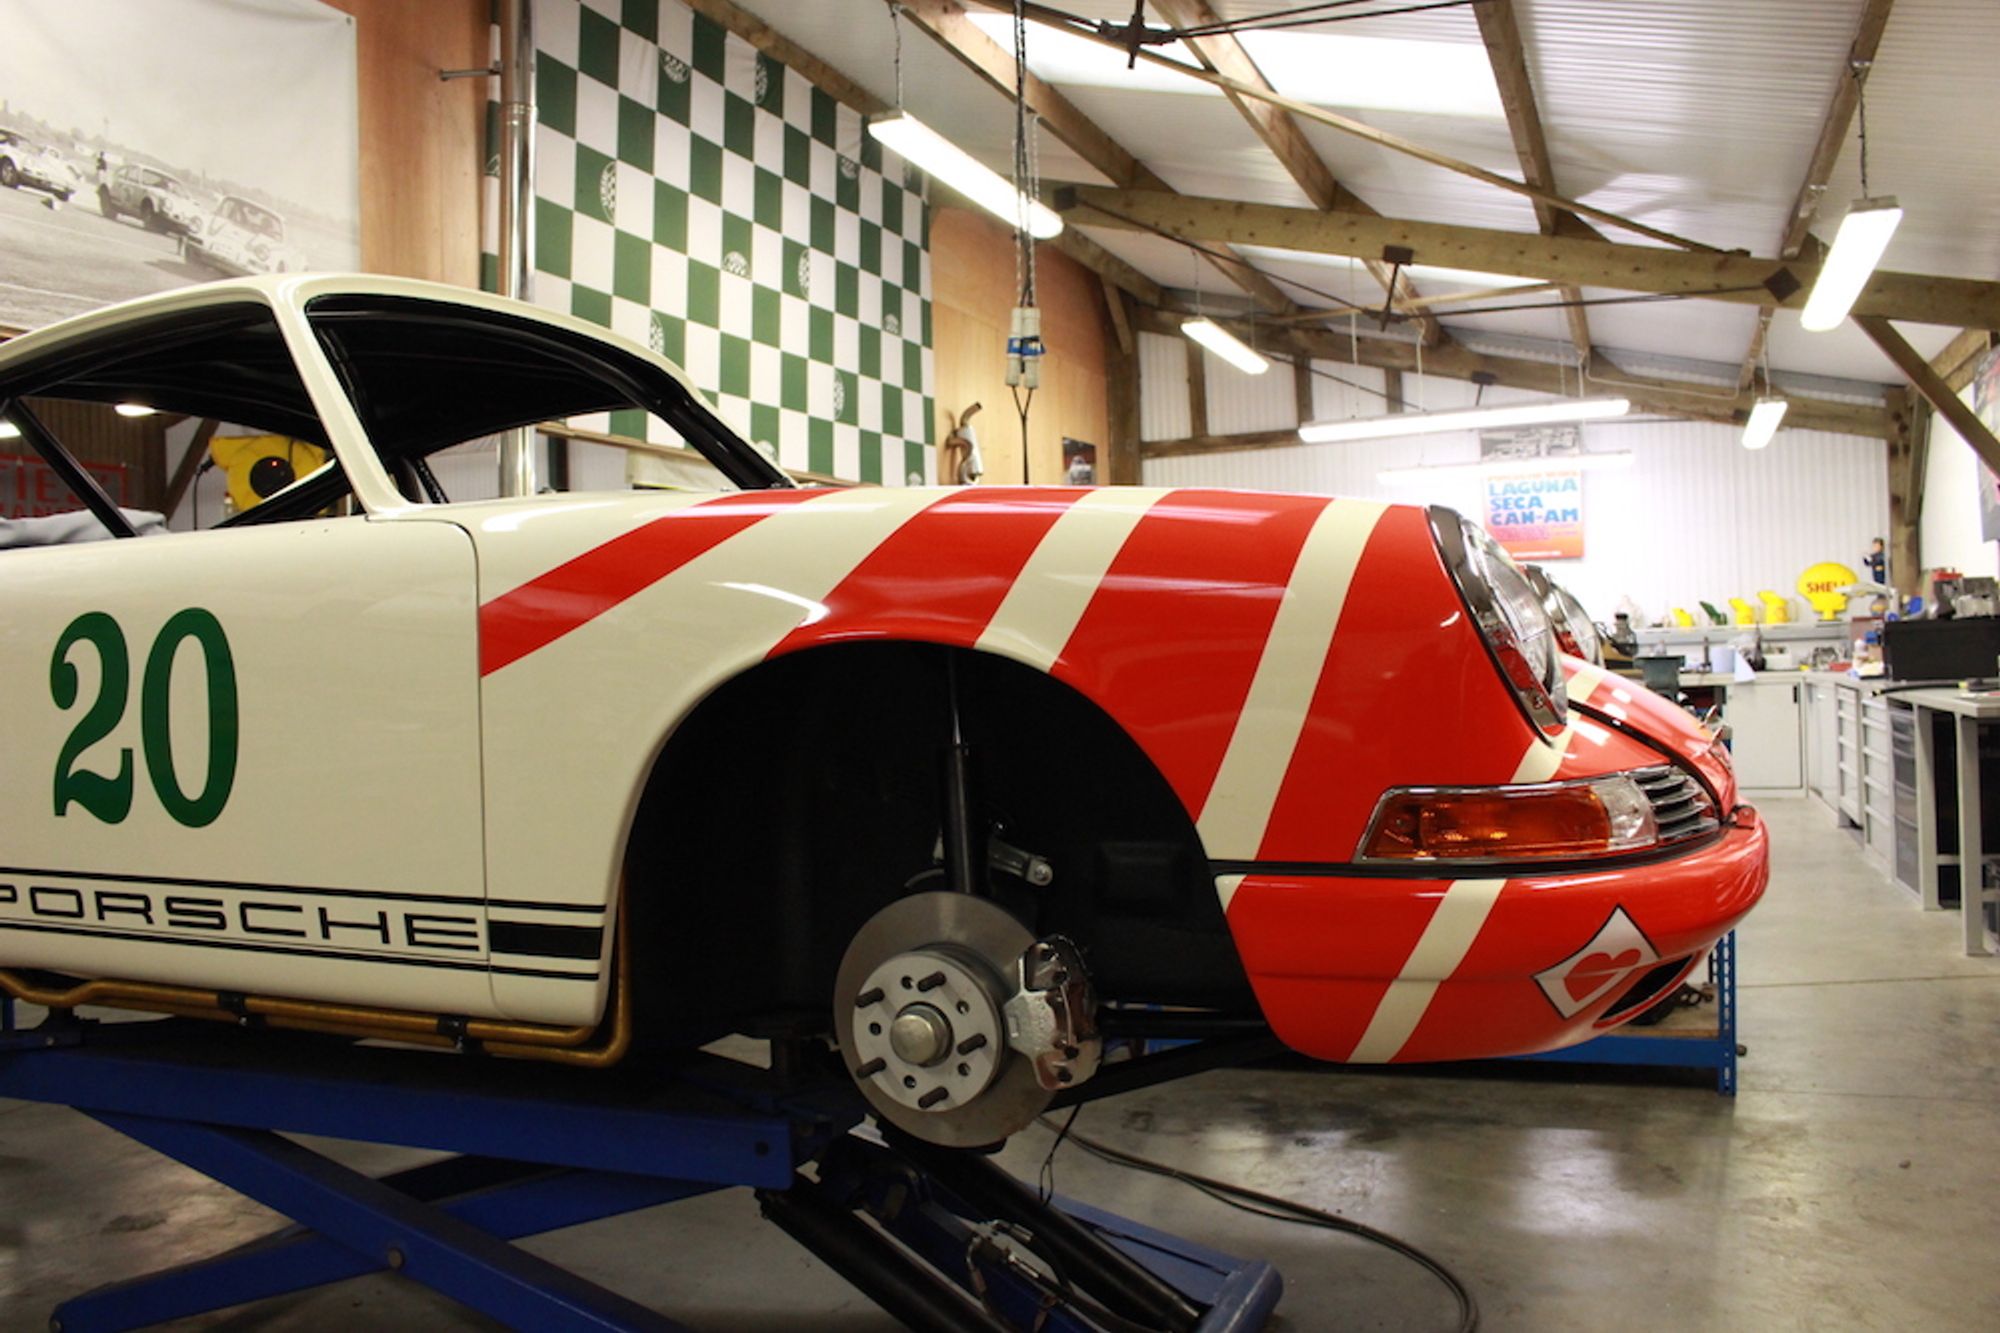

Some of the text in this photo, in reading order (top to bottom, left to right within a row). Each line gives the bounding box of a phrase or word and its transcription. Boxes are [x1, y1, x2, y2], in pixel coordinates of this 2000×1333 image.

[1488, 478, 1578, 497] LAGUNA
[1490, 496, 1543, 512] SECA
[1490, 508, 1579, 526] CAN-AM
[50, 607, 239, 828] 20
